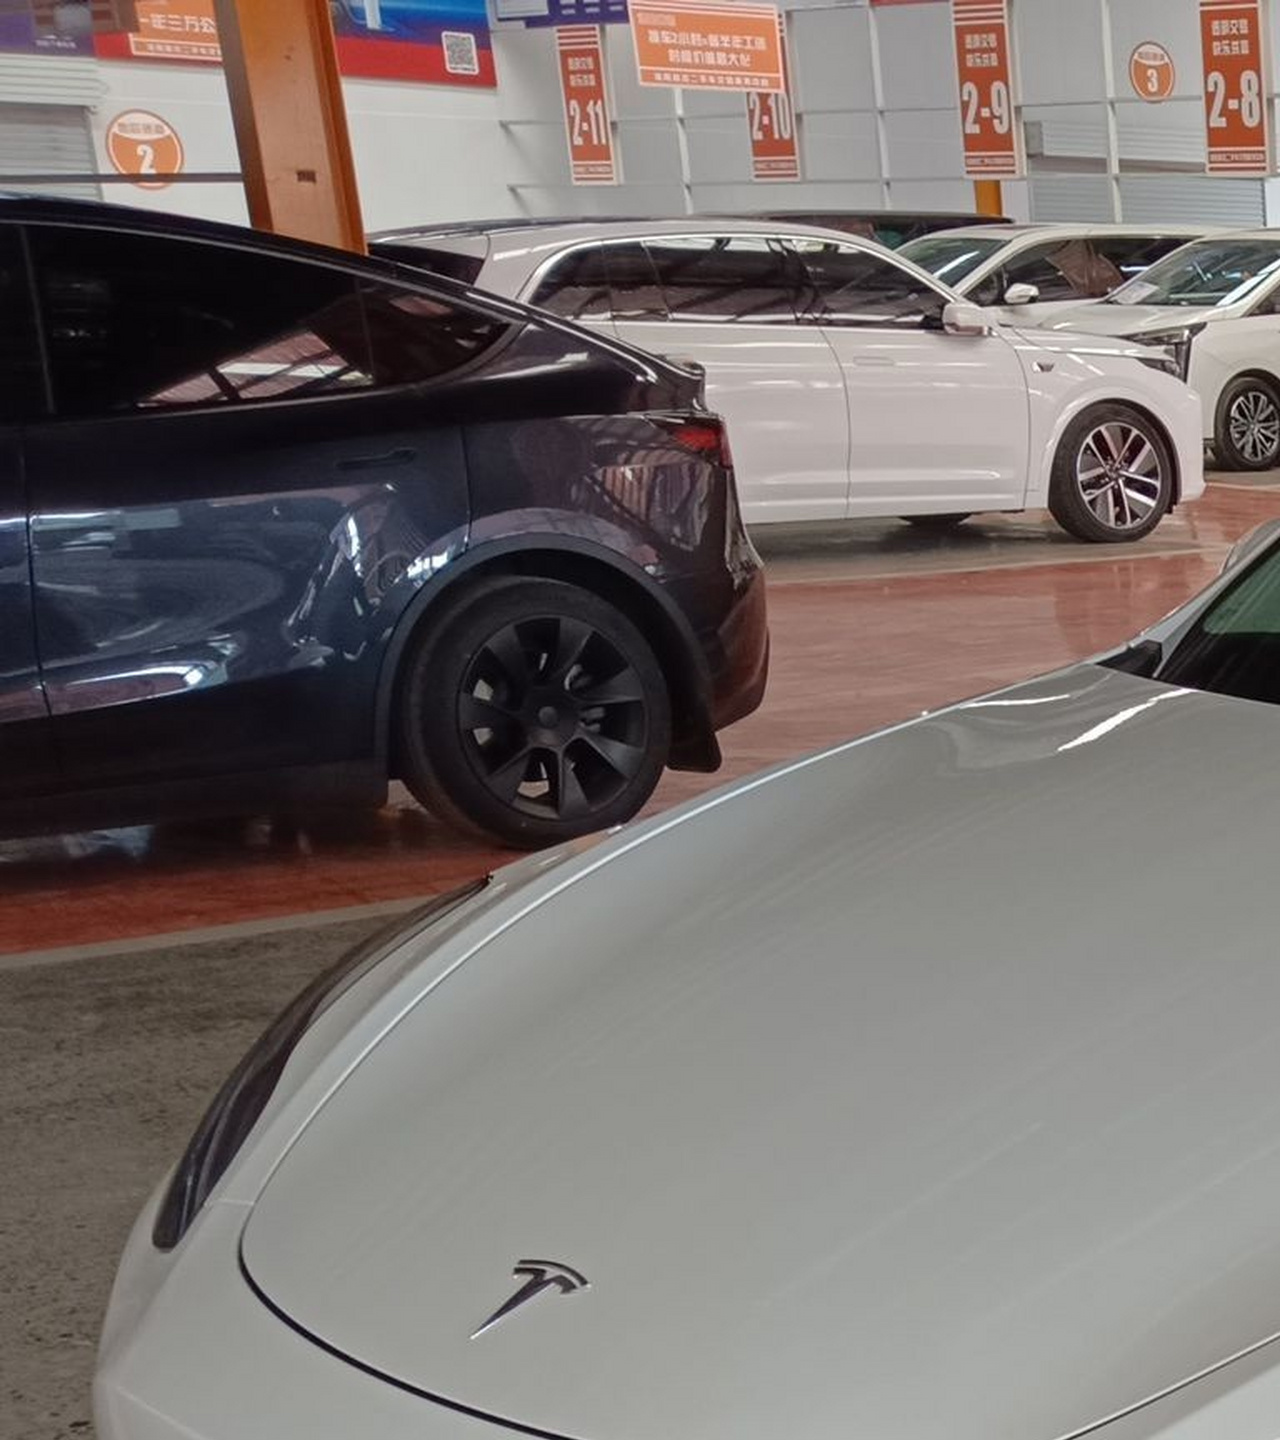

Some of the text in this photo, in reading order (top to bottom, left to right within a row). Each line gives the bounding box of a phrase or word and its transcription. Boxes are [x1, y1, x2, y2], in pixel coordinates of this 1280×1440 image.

[1147, 69, 1159, 93] 3
[1206, 70, 1262, 128] 2-8
[569, 100, 607, 145] 2-11
[962, 80, 1010, 134] 2-9
